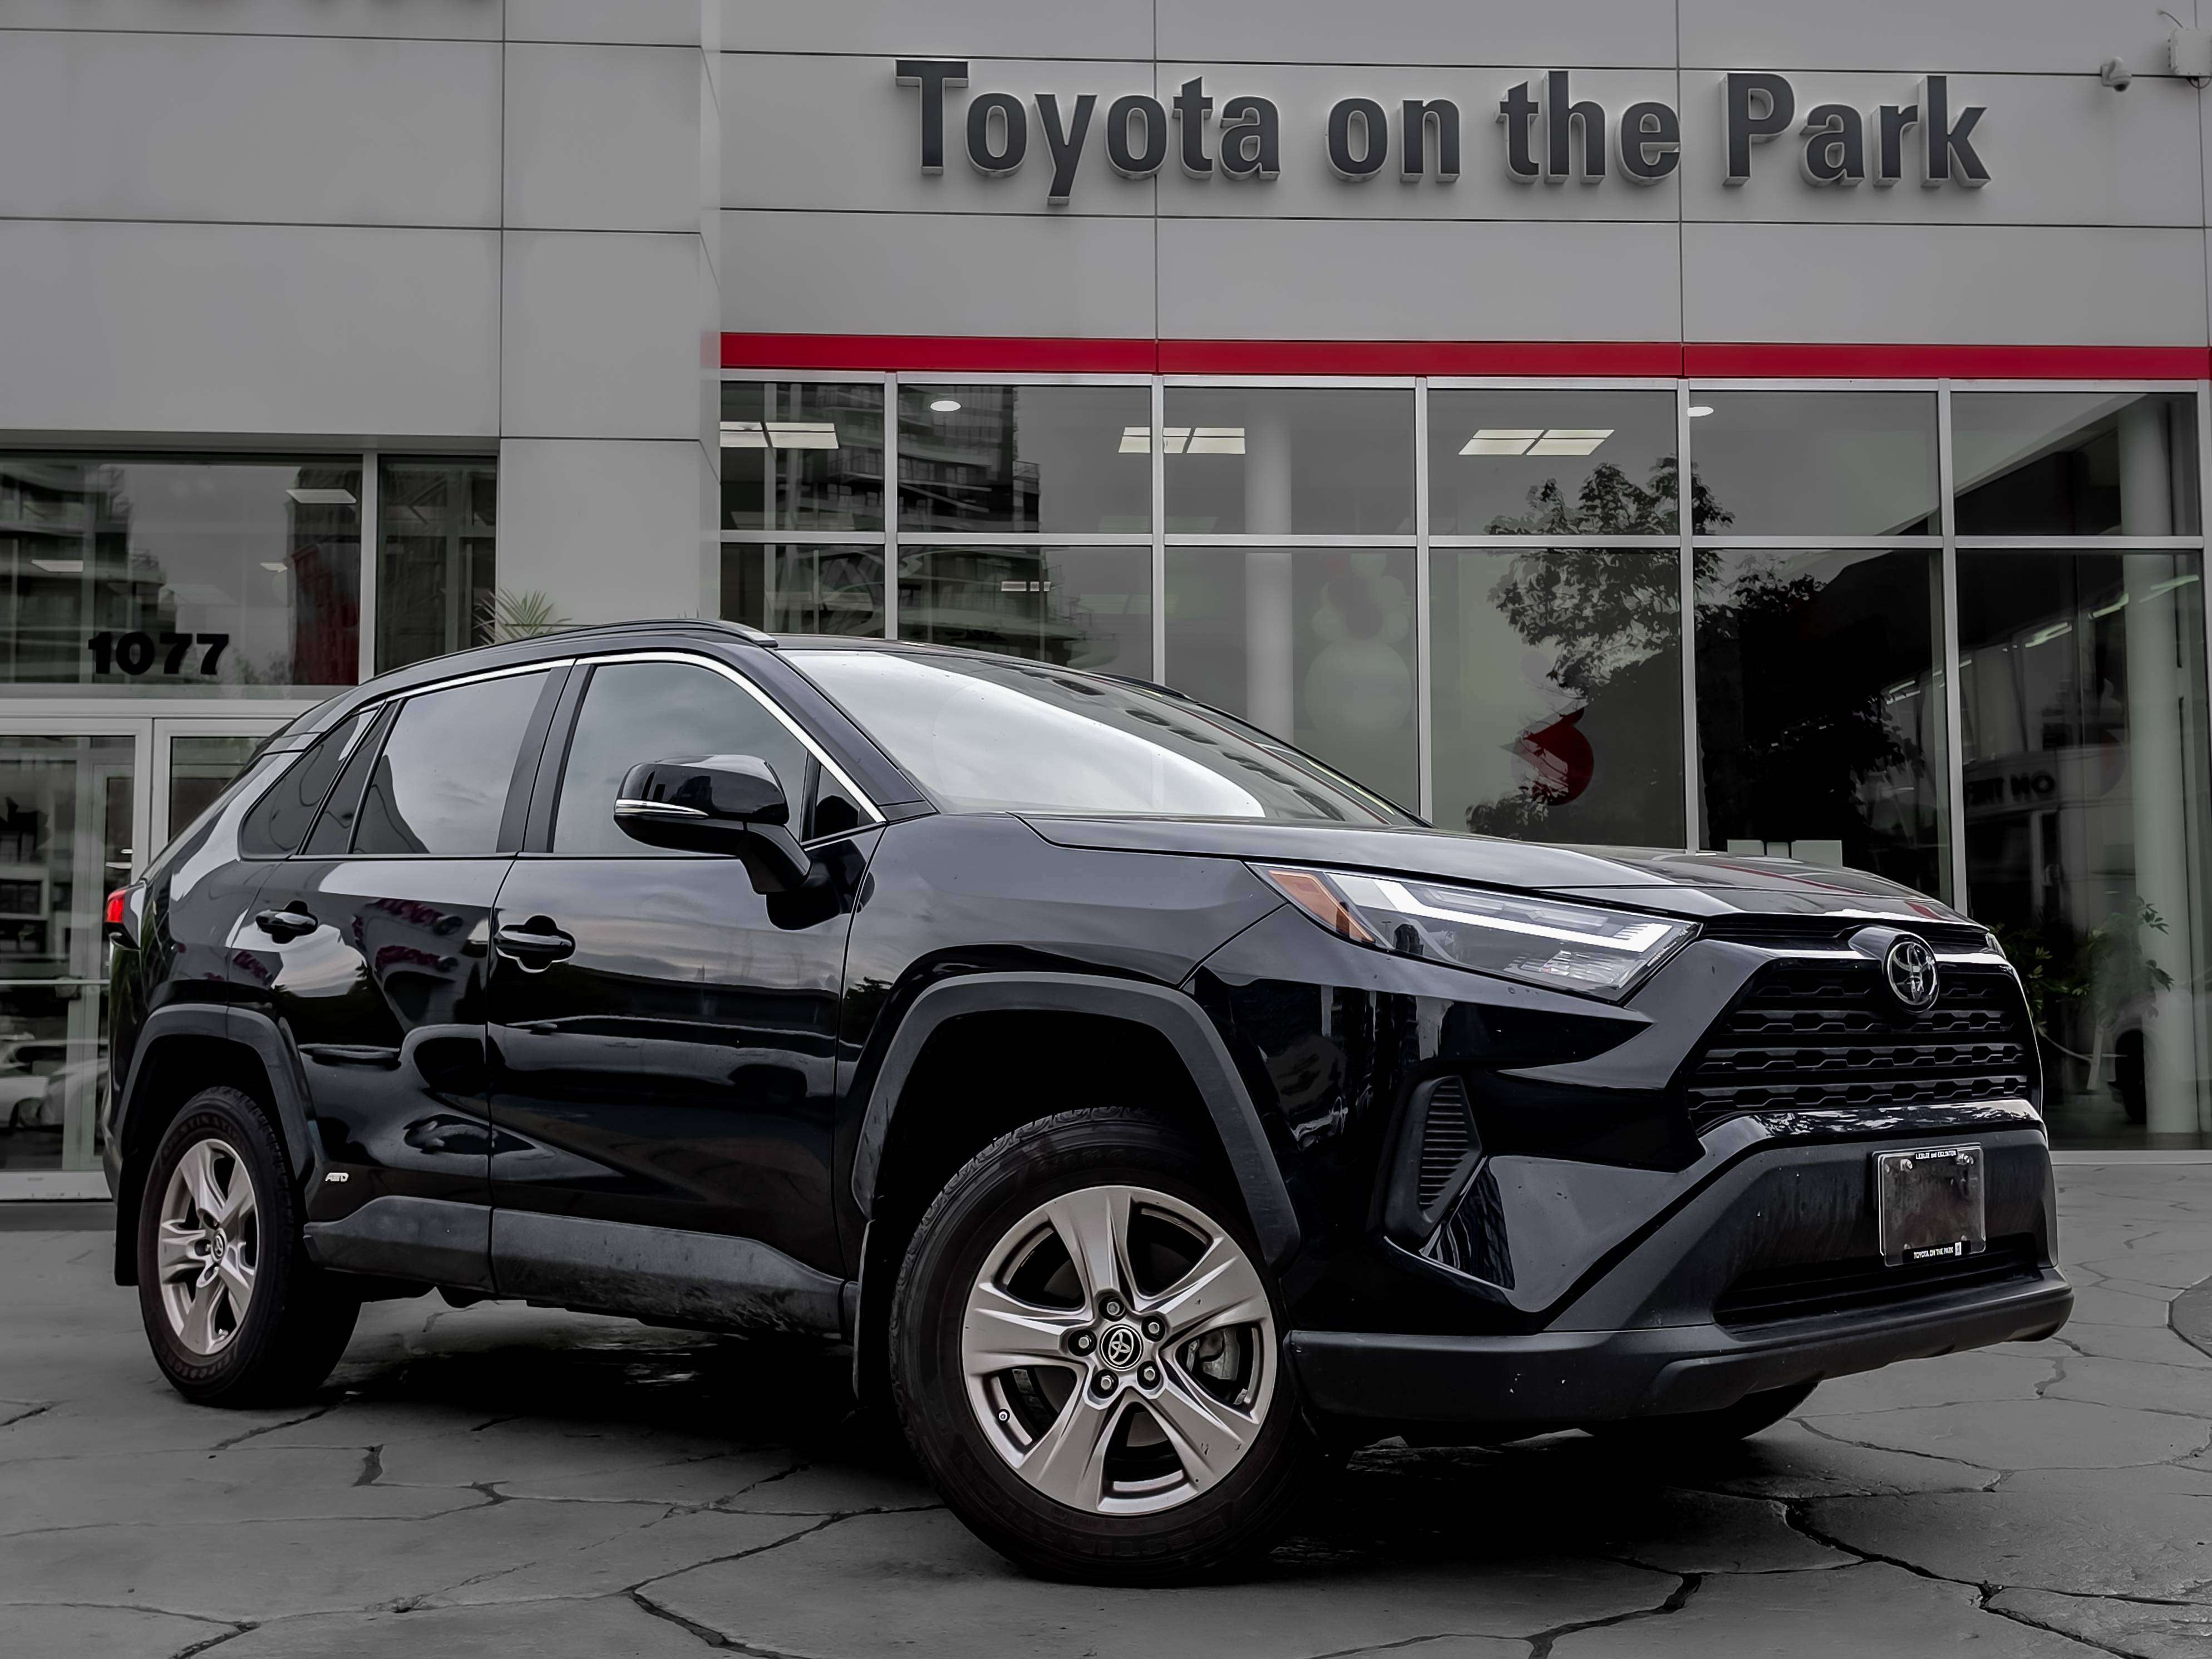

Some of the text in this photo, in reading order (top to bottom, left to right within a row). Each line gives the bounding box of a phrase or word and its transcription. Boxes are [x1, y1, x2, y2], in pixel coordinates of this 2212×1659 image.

[895, 58, 1992, 204] Toyota on the Park
[88, 631, 229, 675] 1077
[1913, 1250, 1929, 1259] TOYOTA
